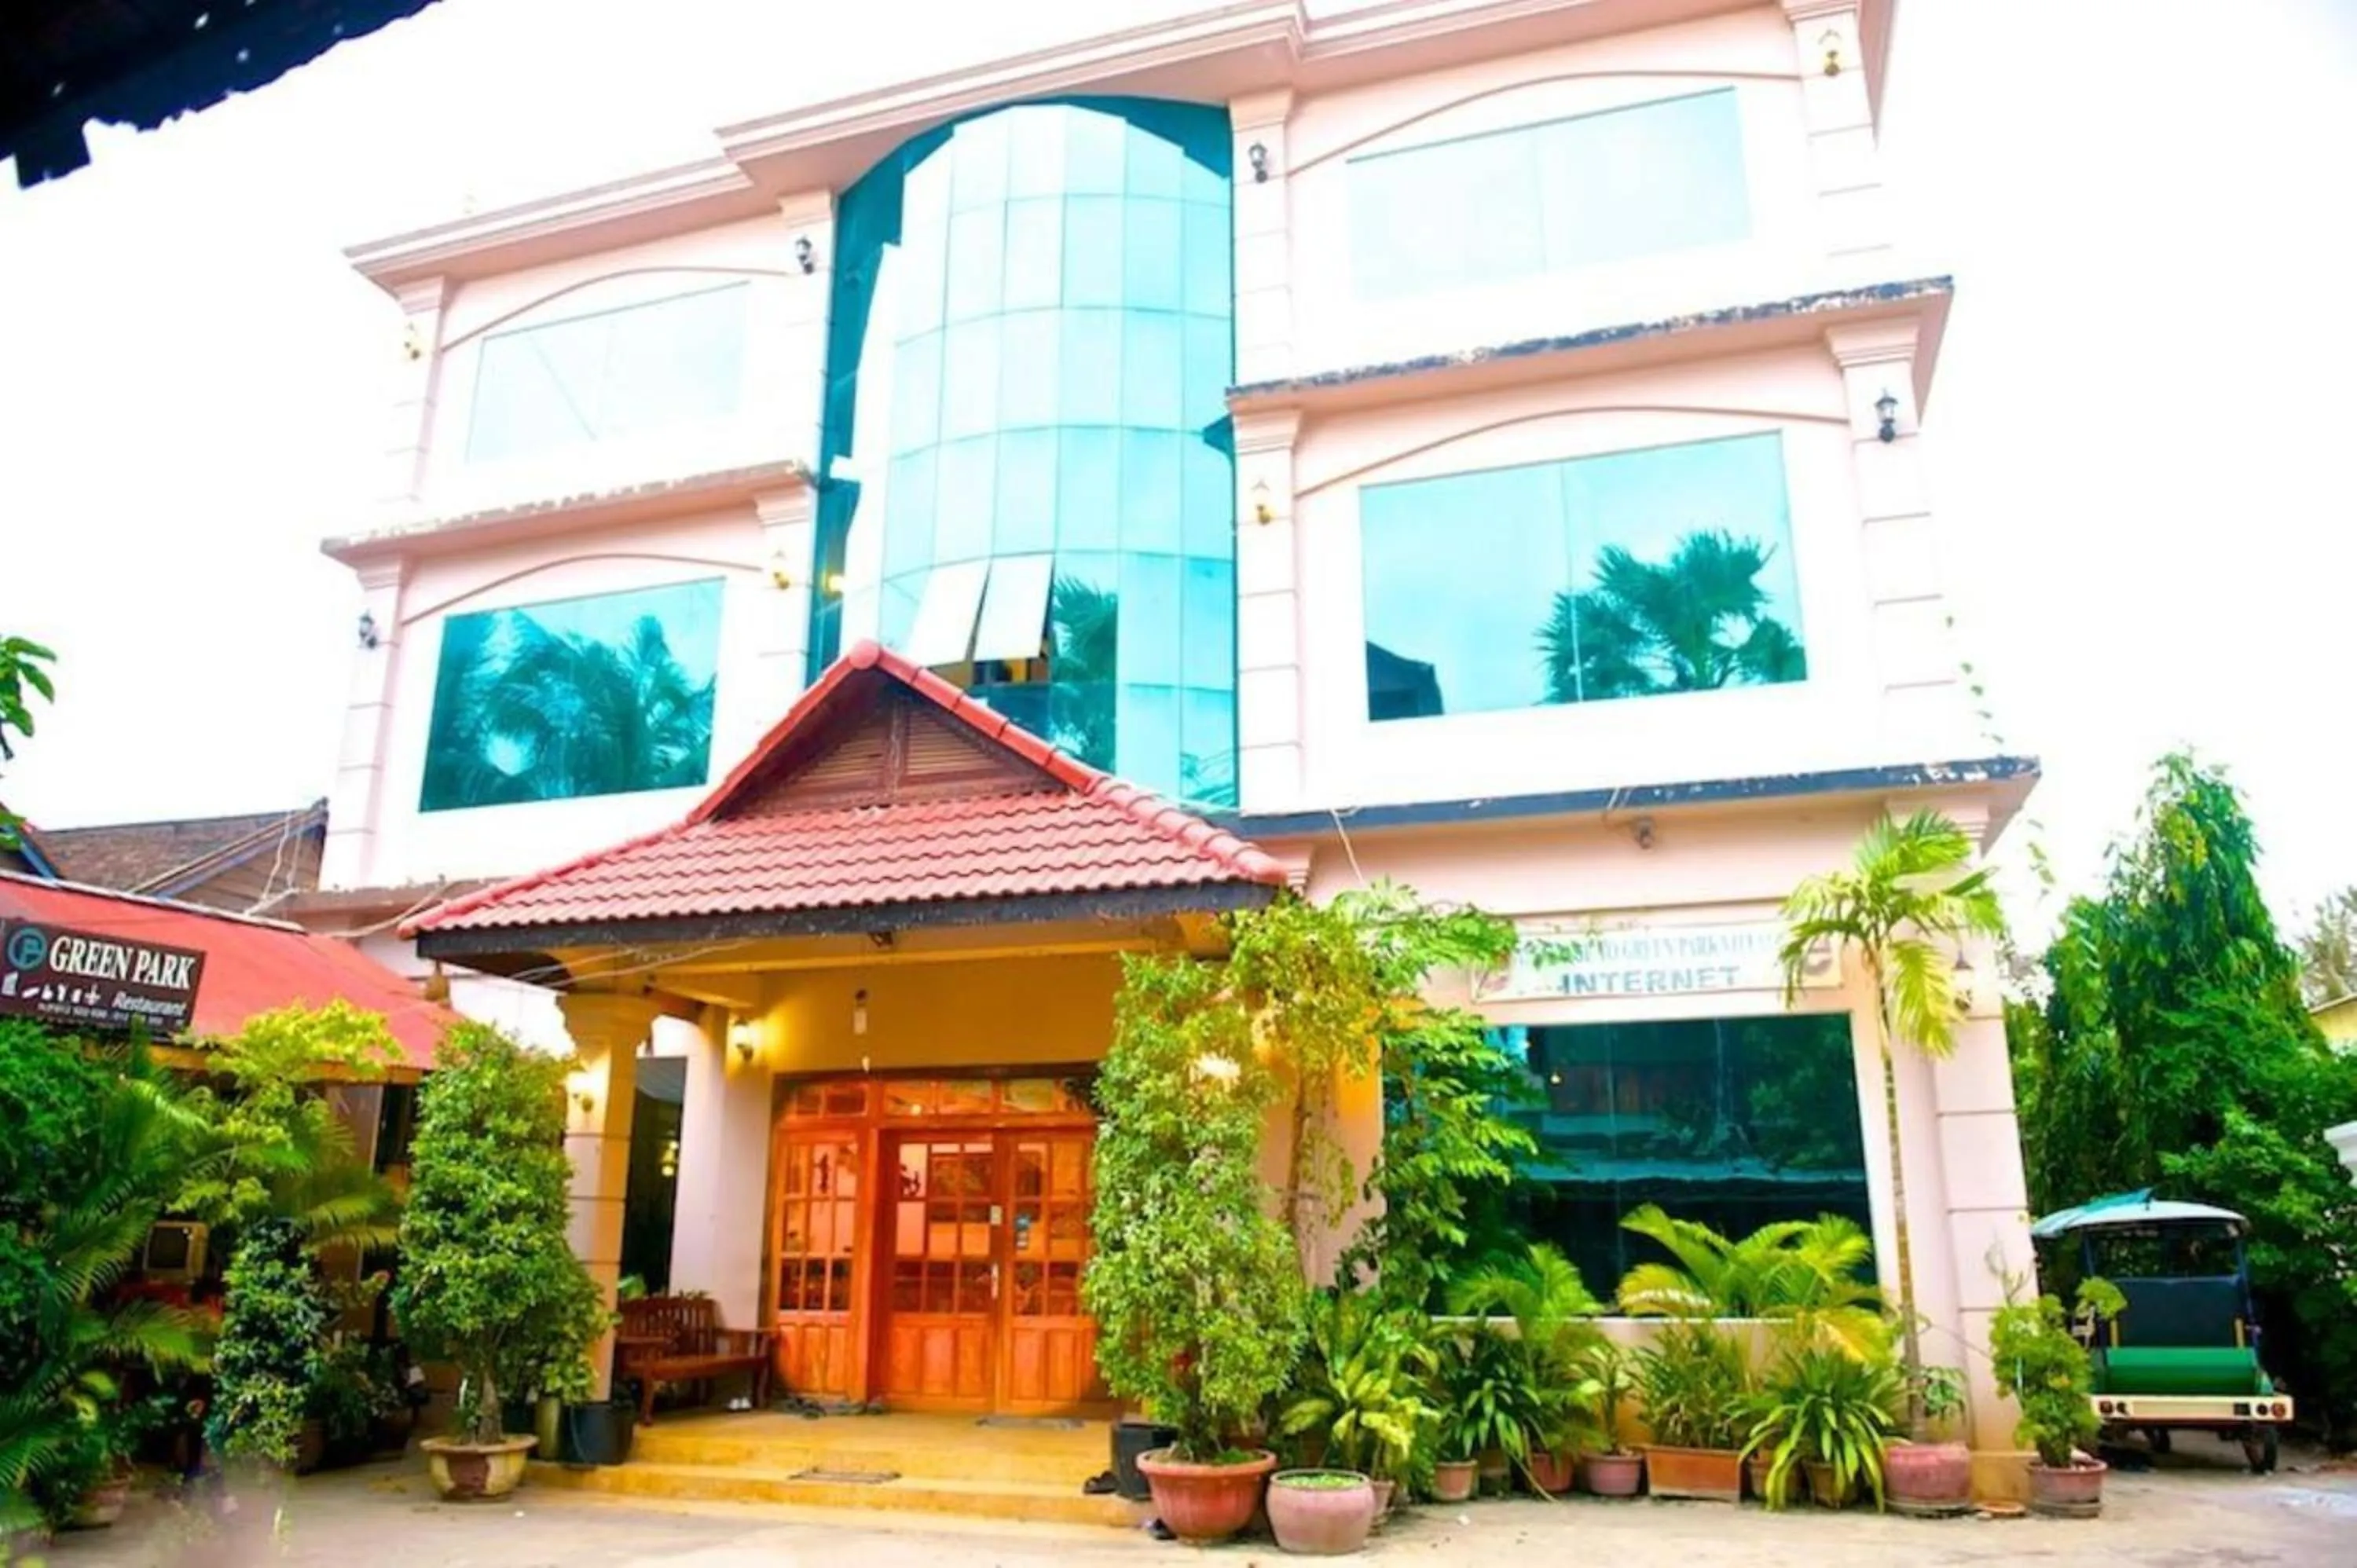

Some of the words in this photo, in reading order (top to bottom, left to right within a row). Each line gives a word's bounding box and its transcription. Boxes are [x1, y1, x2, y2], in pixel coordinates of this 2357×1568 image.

[49, 936, 134, 980] GREEN
[132, 947, 196, 990] PARK
[1560, 965, 1739, 995] INTERNET
